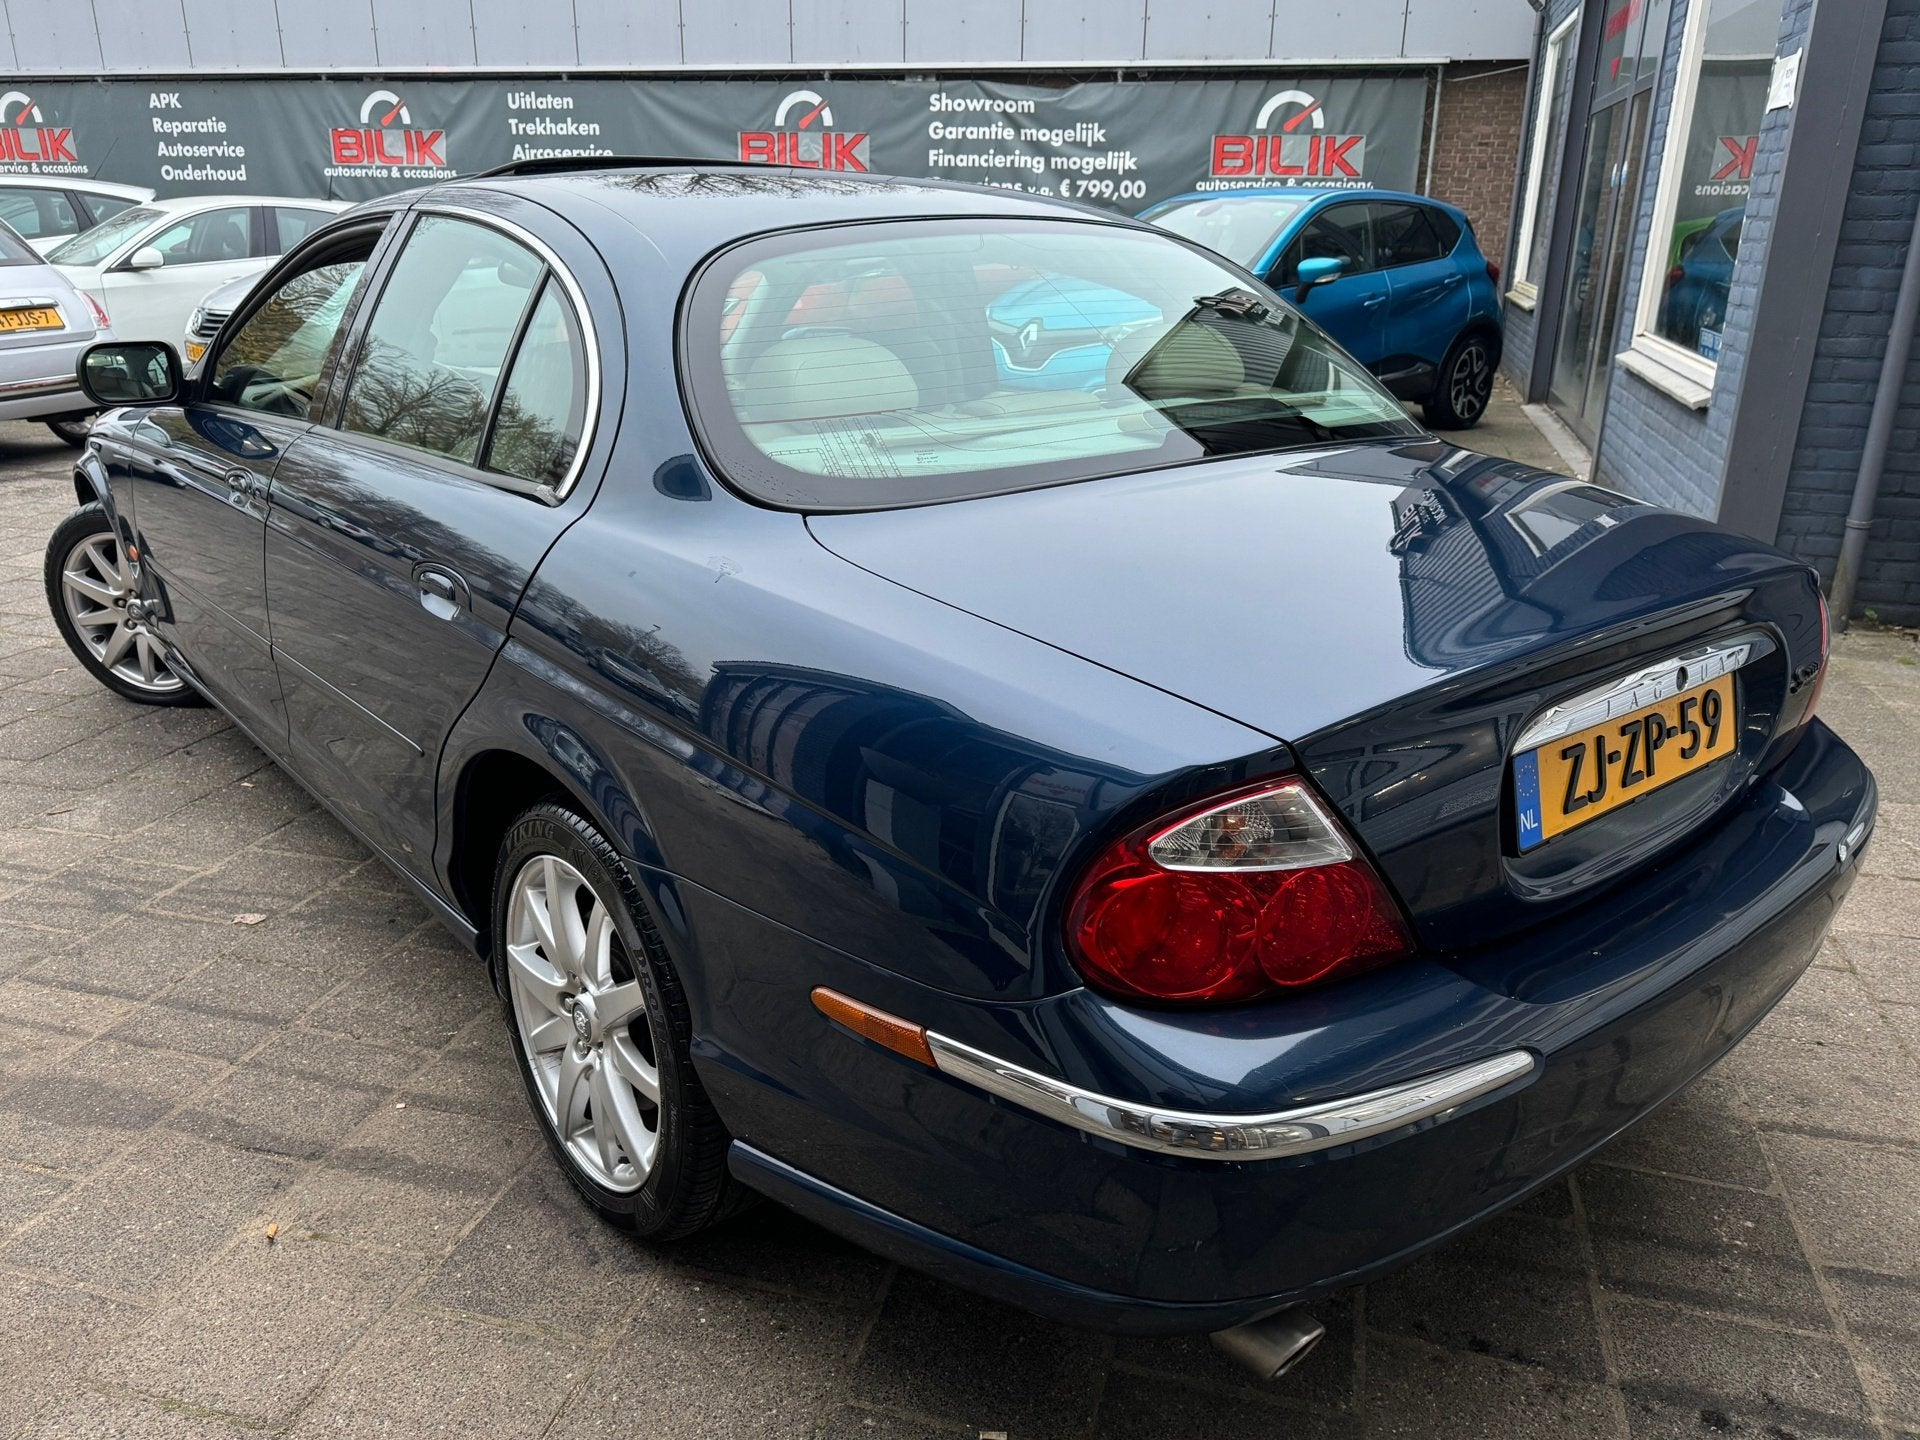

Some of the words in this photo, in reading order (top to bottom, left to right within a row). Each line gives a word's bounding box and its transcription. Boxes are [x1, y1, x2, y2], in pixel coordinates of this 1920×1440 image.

[150, 93, 182, 108] APK
[507, 92, 573, 110] Uitlaten
[929, 92, 1035, 113] Showroom
[152, 117, 227, 137] Reparatie
[508, 118, 600, 136] Trekhaken
[929, 121, 1014, 140] Garantie
[1020, 123, 1106, 147] mogelijk
[0, 128, 76, 161] ILIK
[158, 141, 245, 157] Autoservice
[331, 128, 445, 165] BILIK
[512, 143, 613, 160] Aircoservice
[740, 132, 868, 172] BILIK
[929, 149, 1045, 174] Financiering
[1050, 151, 1138, 175] mogelijk
[1212, 135, 1364, 176] BILIK
[31, 162, 40, 173] &
[42, 162, 88, 173] occasions
[161, 163, 247, 181] Onderhoud
[324, 166, 388, 178] autoservice
[391, 166, 400, 178] &
[403, 167, 457, 179] occasions
[1060, 180, 1070, 197] €
[1076, 180, 1146, 200] 799,00
[1561, 689, 1722, 815] ZJ-ZP-59
[1520, 809, 1538, 832] NL
[505, 820, 556, 853] VIKING
